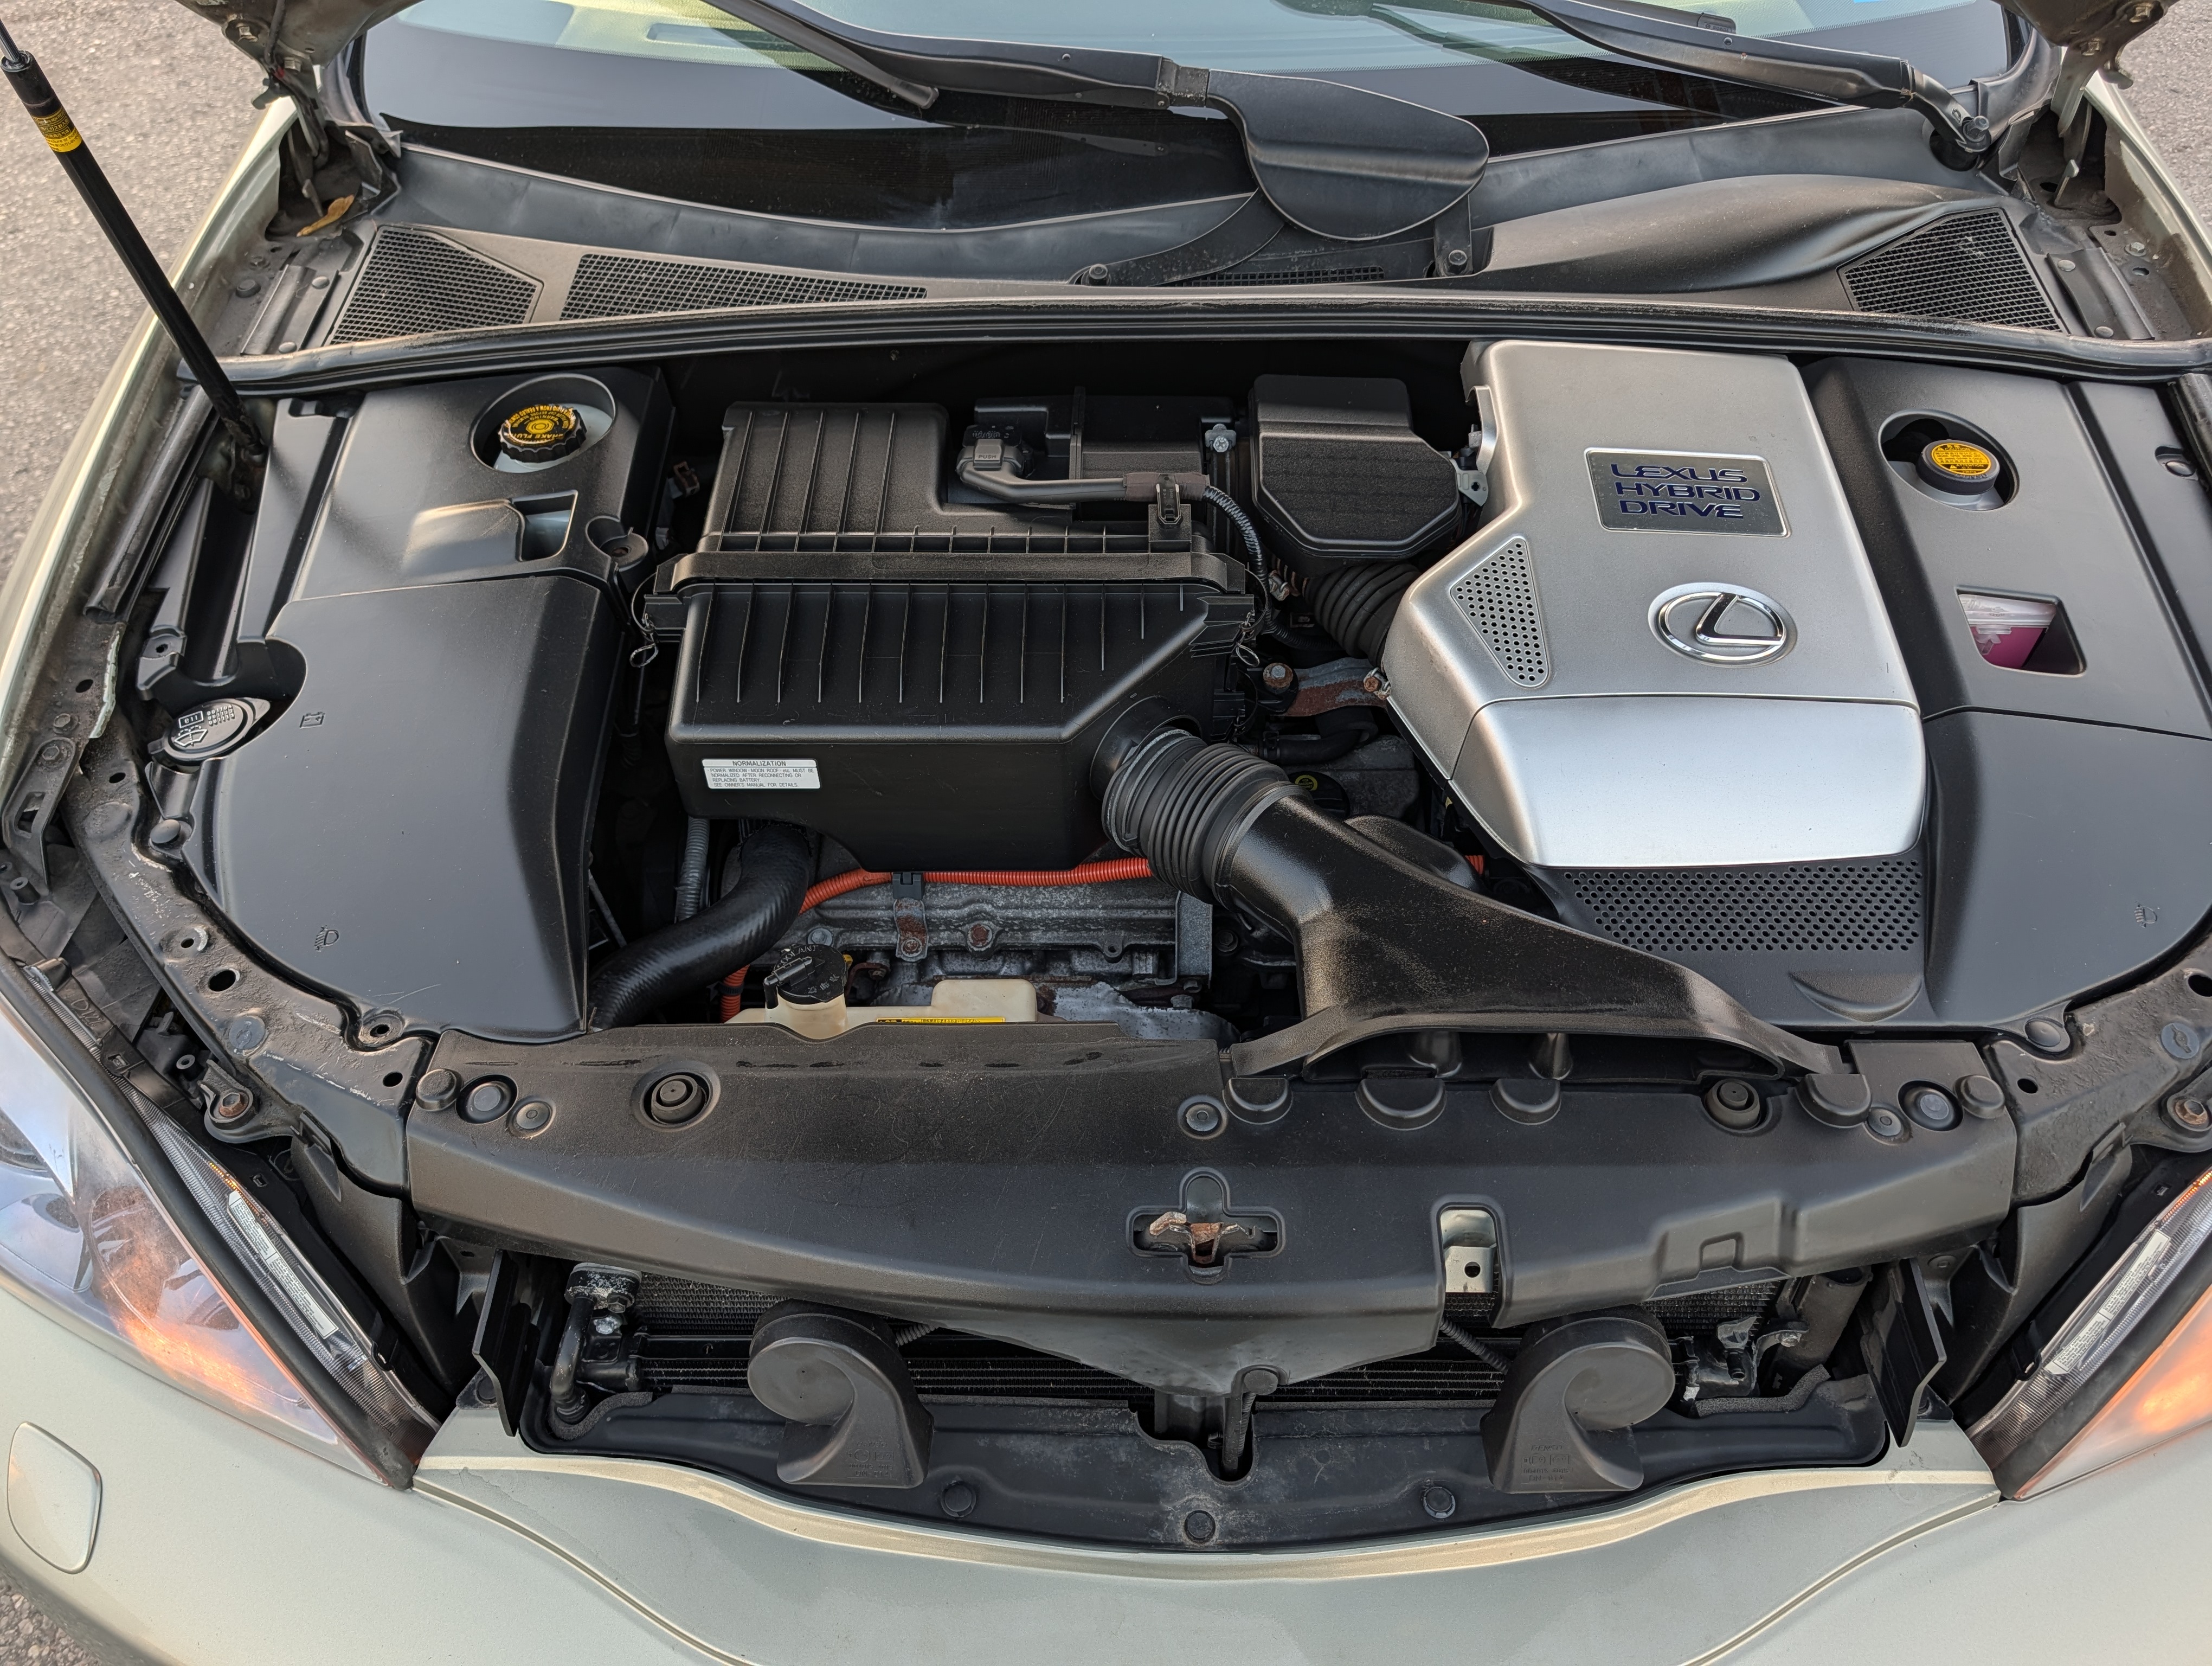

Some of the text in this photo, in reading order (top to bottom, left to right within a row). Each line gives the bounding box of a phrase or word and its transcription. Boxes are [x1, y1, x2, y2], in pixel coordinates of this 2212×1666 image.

[1611, 464, 1747, 483] LEXUS
[1615, 482, 1760, 502] HYBRID
[1619, 500, 1744, 519] DRIVE
